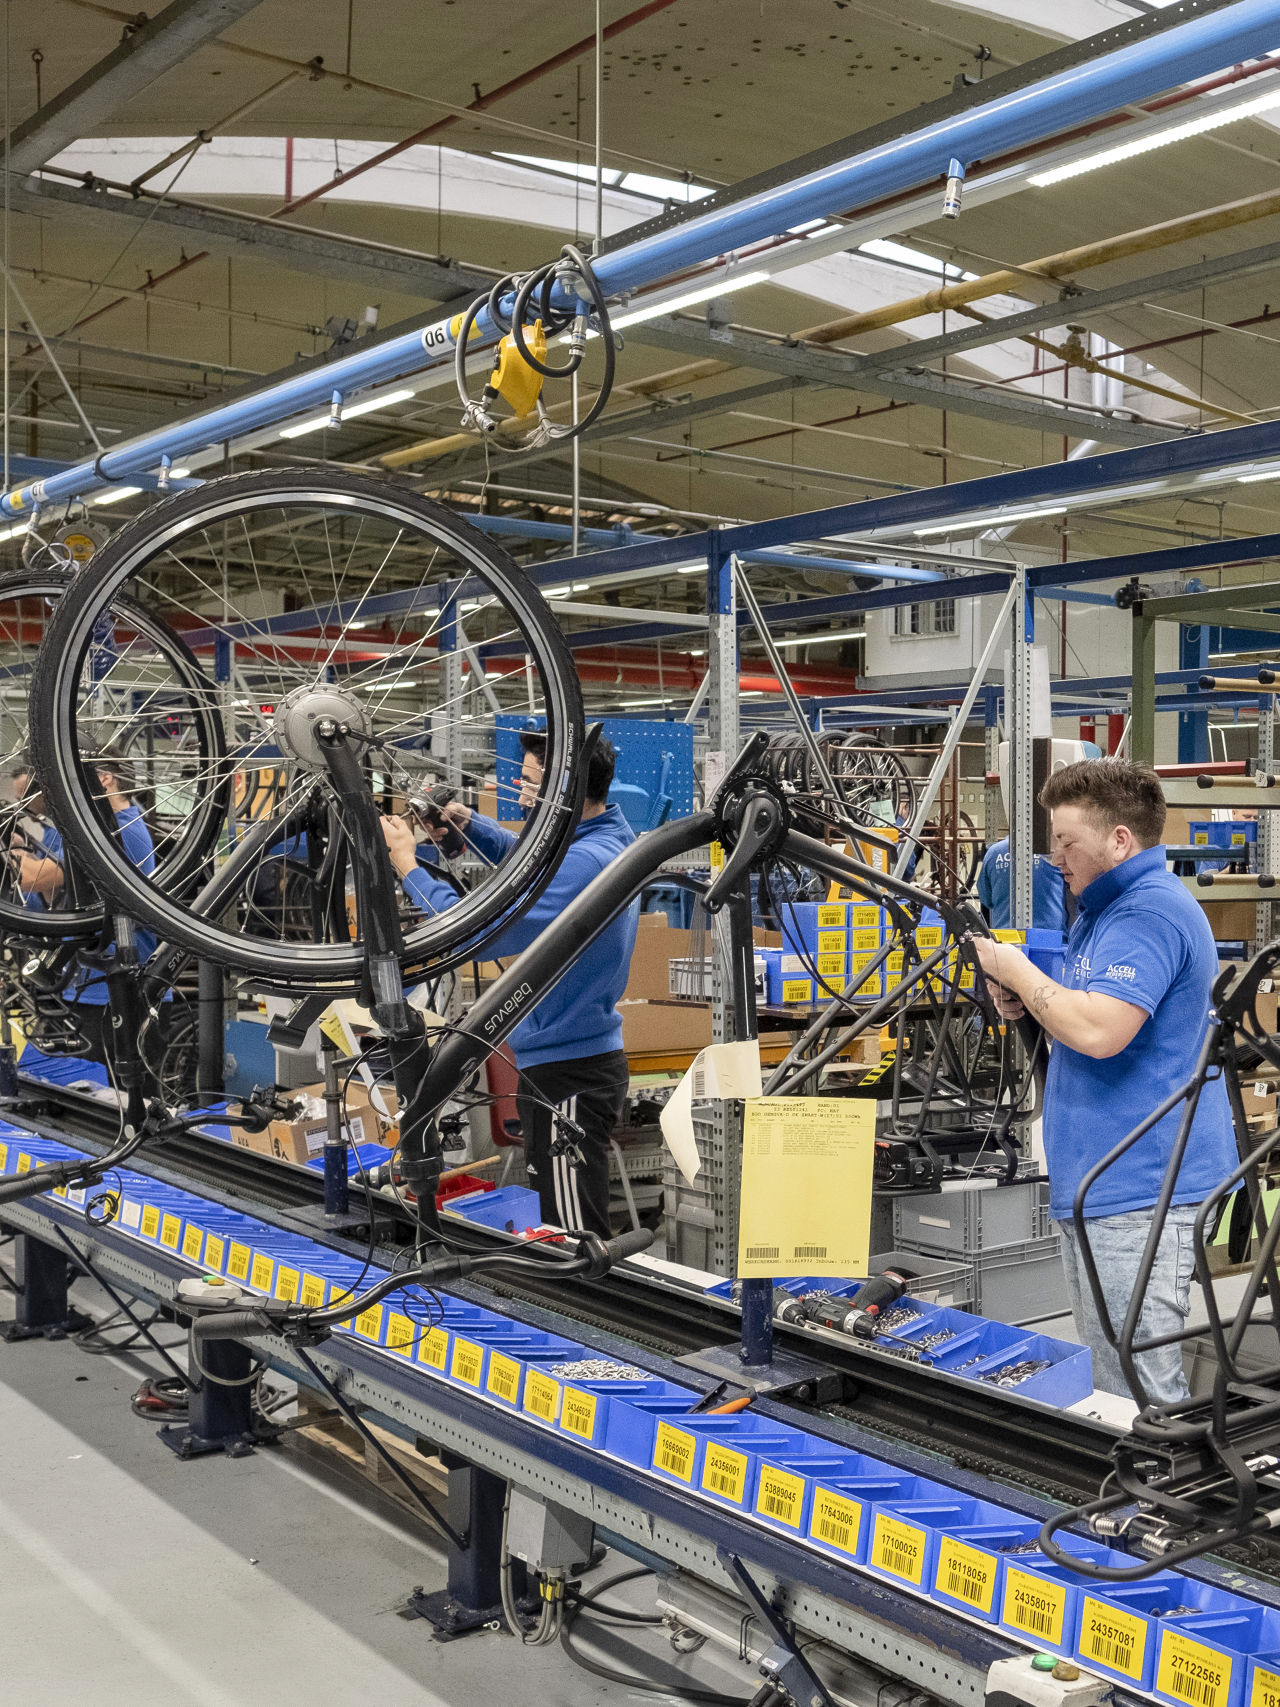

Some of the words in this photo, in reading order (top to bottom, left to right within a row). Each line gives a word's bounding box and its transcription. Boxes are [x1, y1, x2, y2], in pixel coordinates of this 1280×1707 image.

[425, 326, 445, 348] 06
[566, 721, 574, 768] SCHWALBE
[567, 1401, 591, 1419] 24346038
[662, 1438, 690, 1460] 16669002
[710, 1457, 740, 1477] 24356001
[764, 1482, 796, 1503] 53889045
[820, 1503, 853, 1526] 17643006
[882, 1533, 918, 1558] 17100025
[947, 1558, 987, 1584] 18118058
[1014, 1589, 1057, 1615] 24358017
[1090, 1619, 1135, 1648] 24357081
[1171, 1654, 1222, 1687] 27122565
